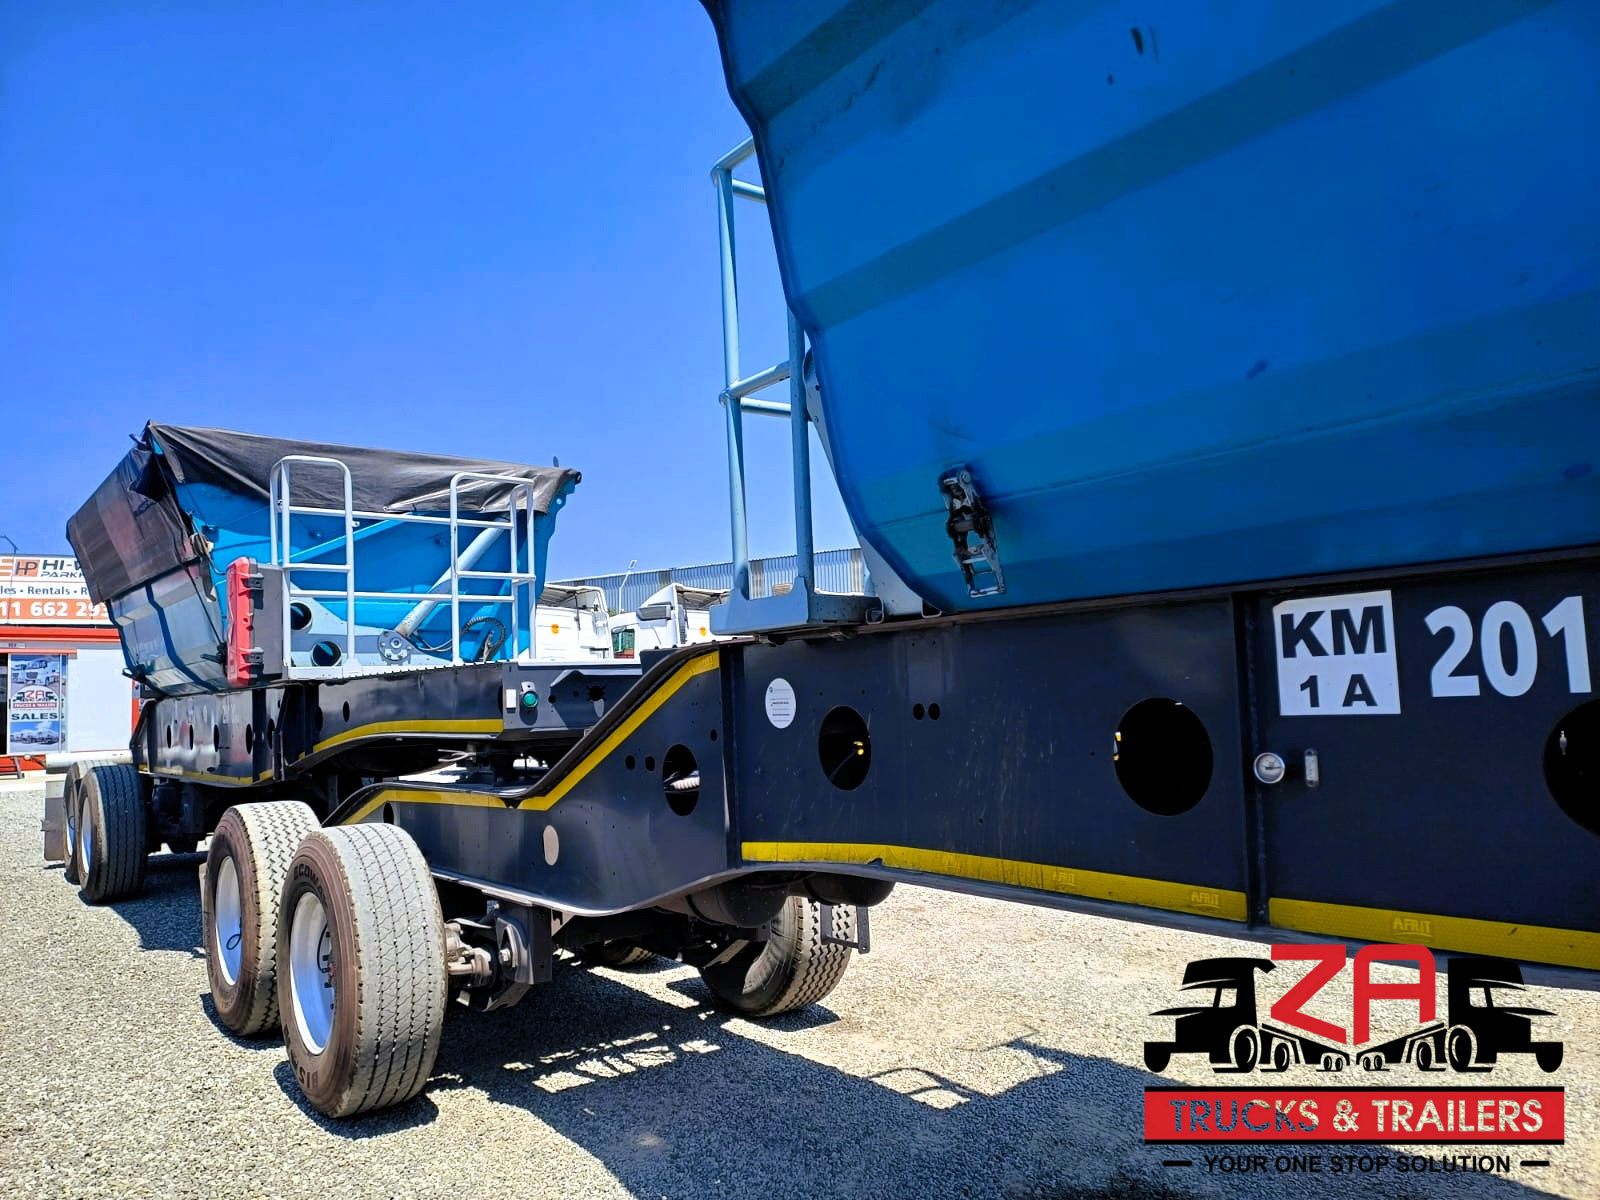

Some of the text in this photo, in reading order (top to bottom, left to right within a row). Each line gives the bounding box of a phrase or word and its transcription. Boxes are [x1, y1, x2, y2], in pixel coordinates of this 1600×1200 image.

[27, 586, 70, 596] Rentals
[30, 602, 69, 617] 662
[1281, 605, 1387, 659] KM
[1424, 596, 1592, 698] 201
